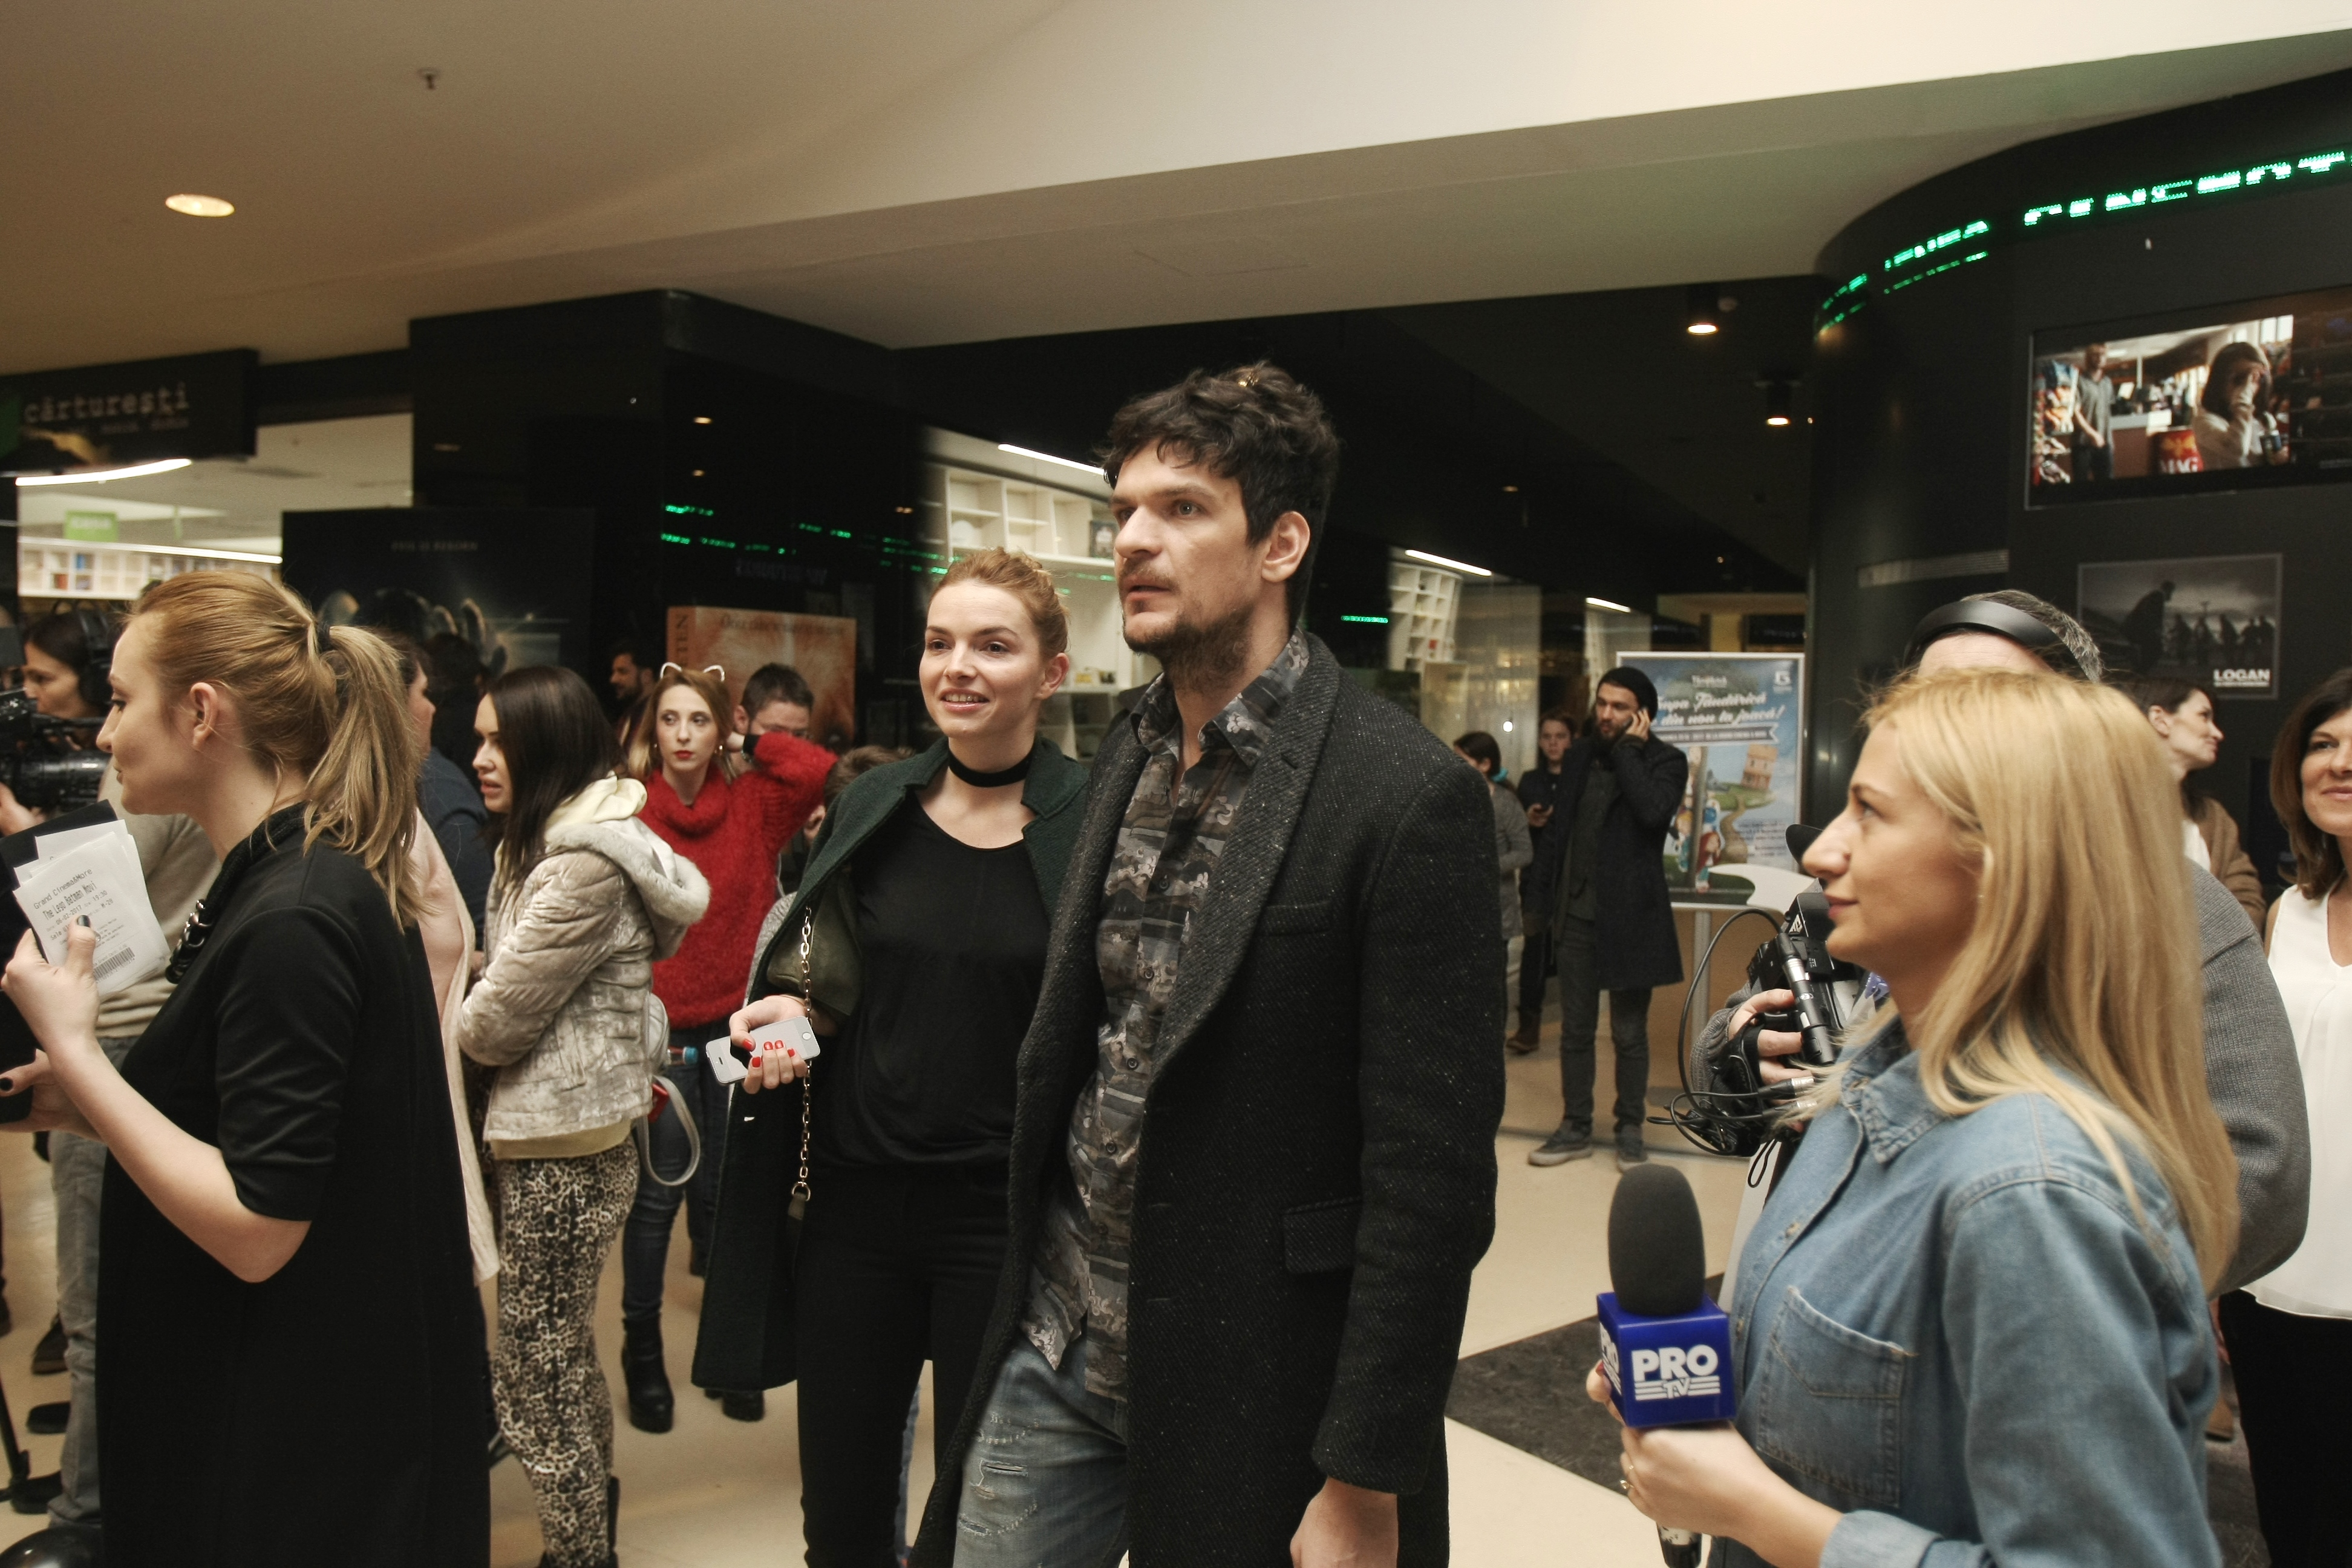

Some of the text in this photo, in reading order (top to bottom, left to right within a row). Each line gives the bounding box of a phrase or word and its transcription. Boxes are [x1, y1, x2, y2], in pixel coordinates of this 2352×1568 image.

[2213, 668, 2270, 682] LOGAN
[33, 869, 93, 909] Grand Cinema&More
[93, 890, 108, 902] 19:30
[42, 910, 54, 921] The
[53, 901, 67, 914] Lego
[64, 890, 85, 906] Batman
[1632, 1344, 1719, 1382] PRO
[1664, 1377, 1691, 1399] TV
